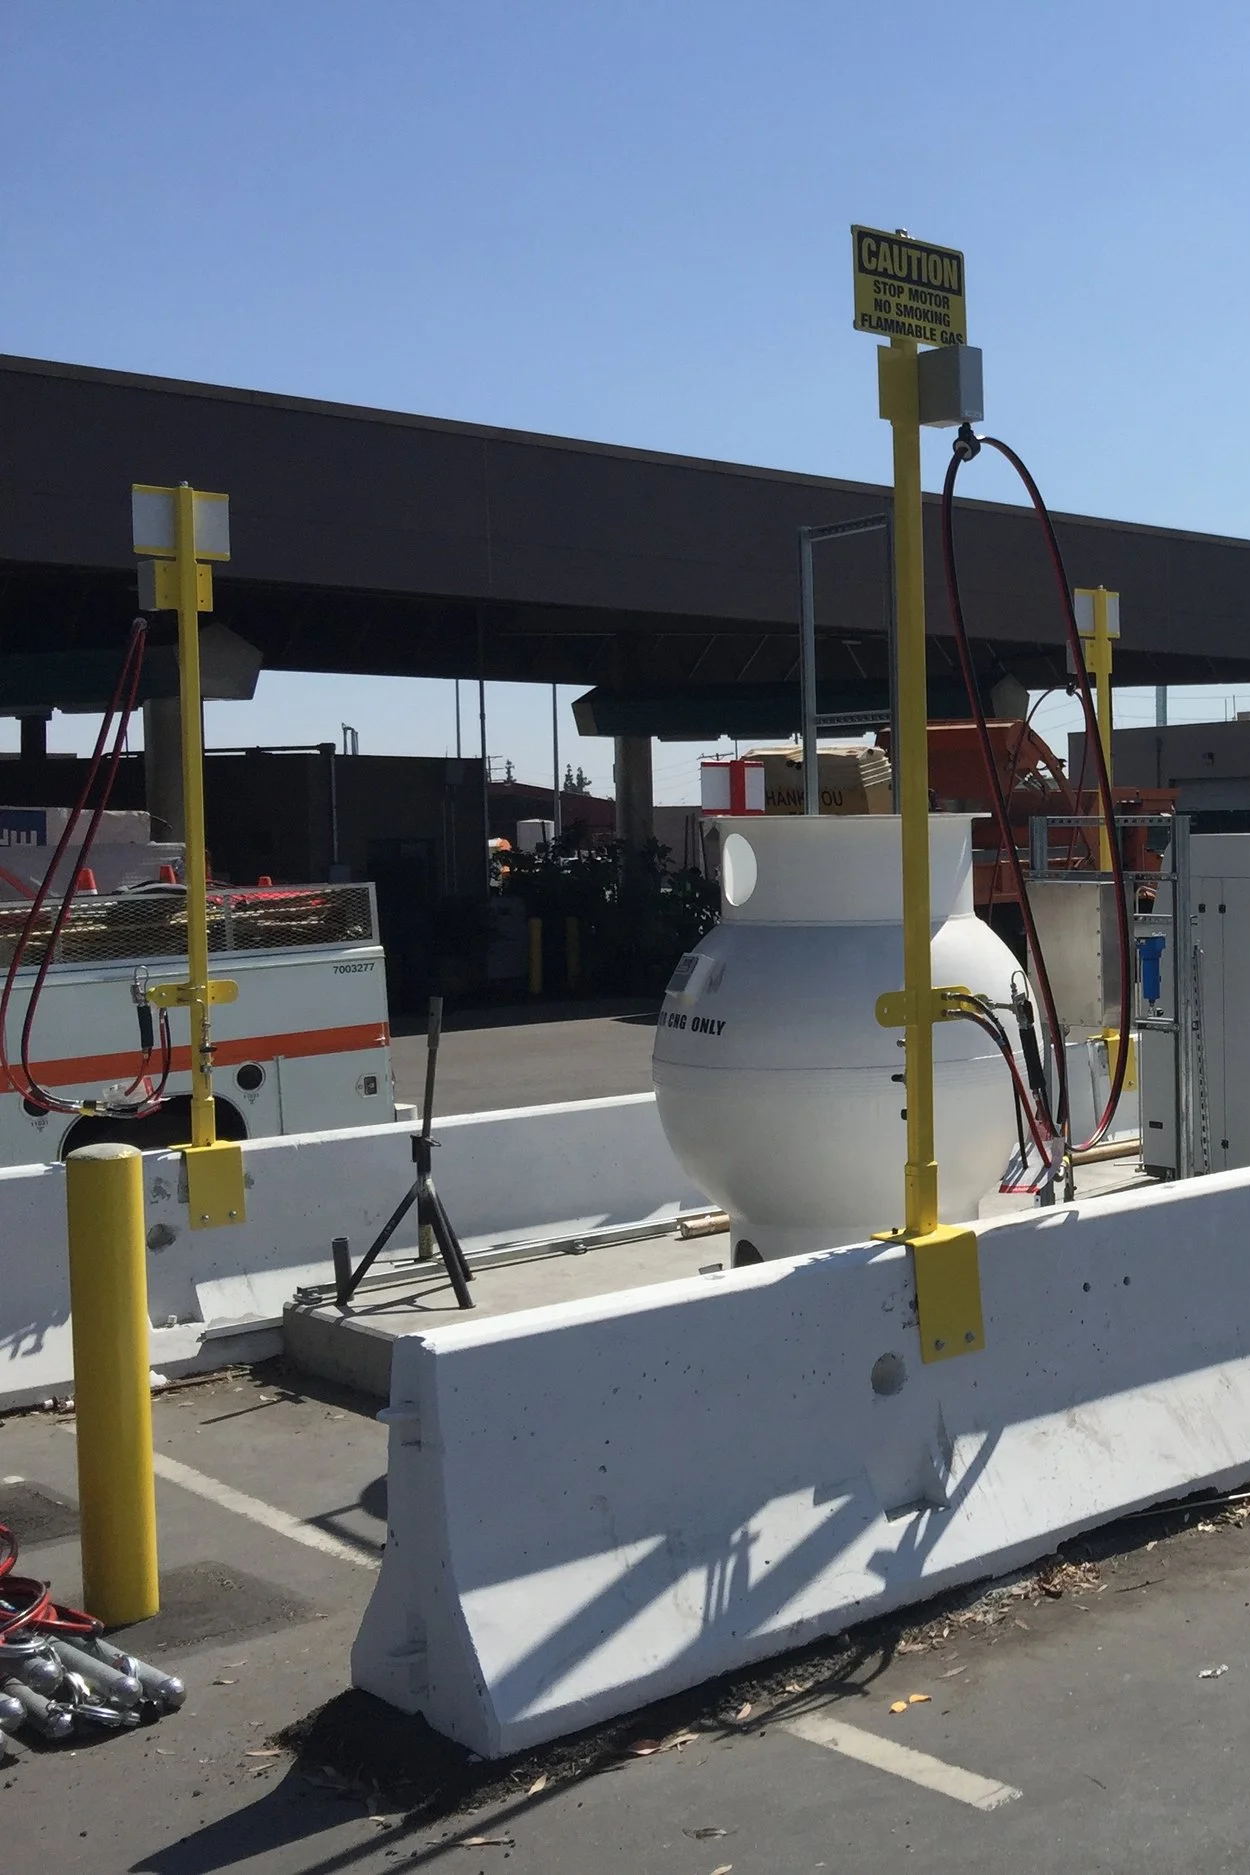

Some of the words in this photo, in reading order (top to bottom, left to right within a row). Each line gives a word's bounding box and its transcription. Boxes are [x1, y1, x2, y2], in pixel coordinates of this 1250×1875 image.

[861, 237, 958, 290] CAUTION
[873, 280, 904, 299] STOP
[908, 287, 950, 310] MOTOR
[874, 298, 892, 314] NO
[895, 302, 950, 327] SMOKING
[861, 313, 937, 341] FLAMMABLE
[940, 330, 963, 345] GAS
[766, 788, 805, 808] HANK
[820, 790, 843, 807] OU
[333, 963, 375, 974] 7003277
[668, 1012, 687, 1030] CNG
[691, 1016, 726, 1036] ONLY
